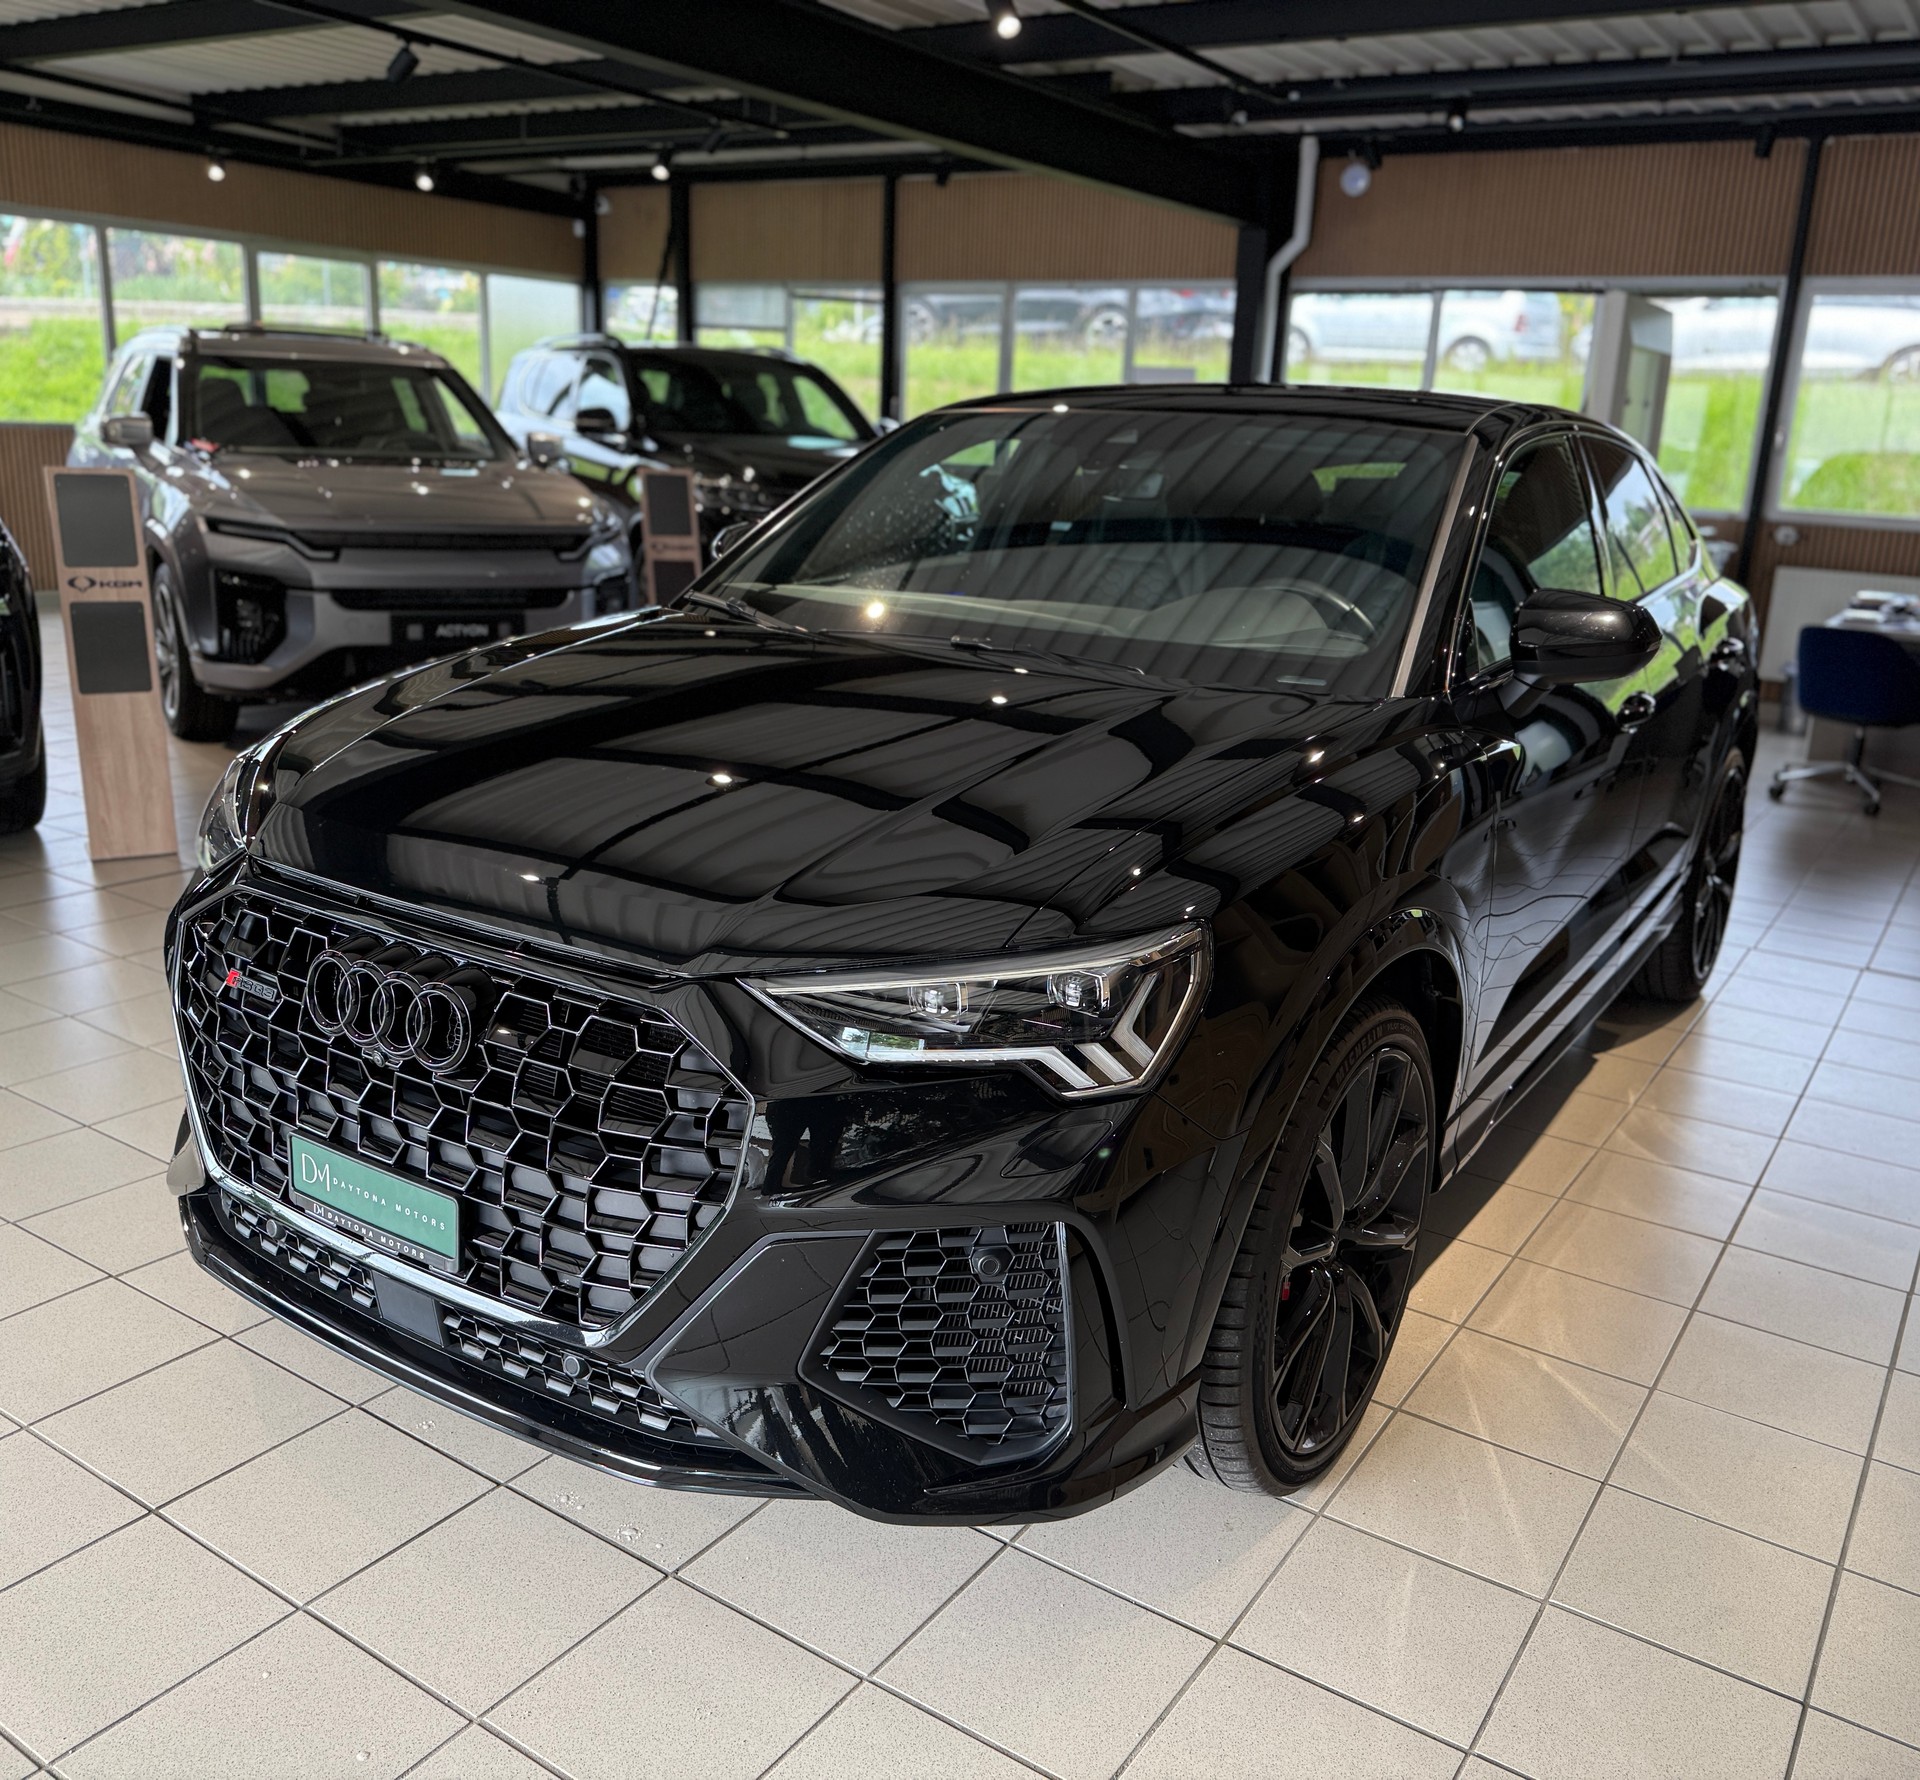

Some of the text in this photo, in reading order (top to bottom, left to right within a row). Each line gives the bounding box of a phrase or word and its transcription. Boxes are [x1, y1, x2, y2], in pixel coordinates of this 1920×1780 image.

[99, 579, 143, 588] KGM
[1335, 1025, 1383, 1087] MICHELIN
[333, 1177, 386, 1206] DAYTONA
[395, 1204, 445, 1231] MOTORS
[328, 1211, 374, 1238] DAYTONA
[380, 1235, 425, 1260] MOTORS
